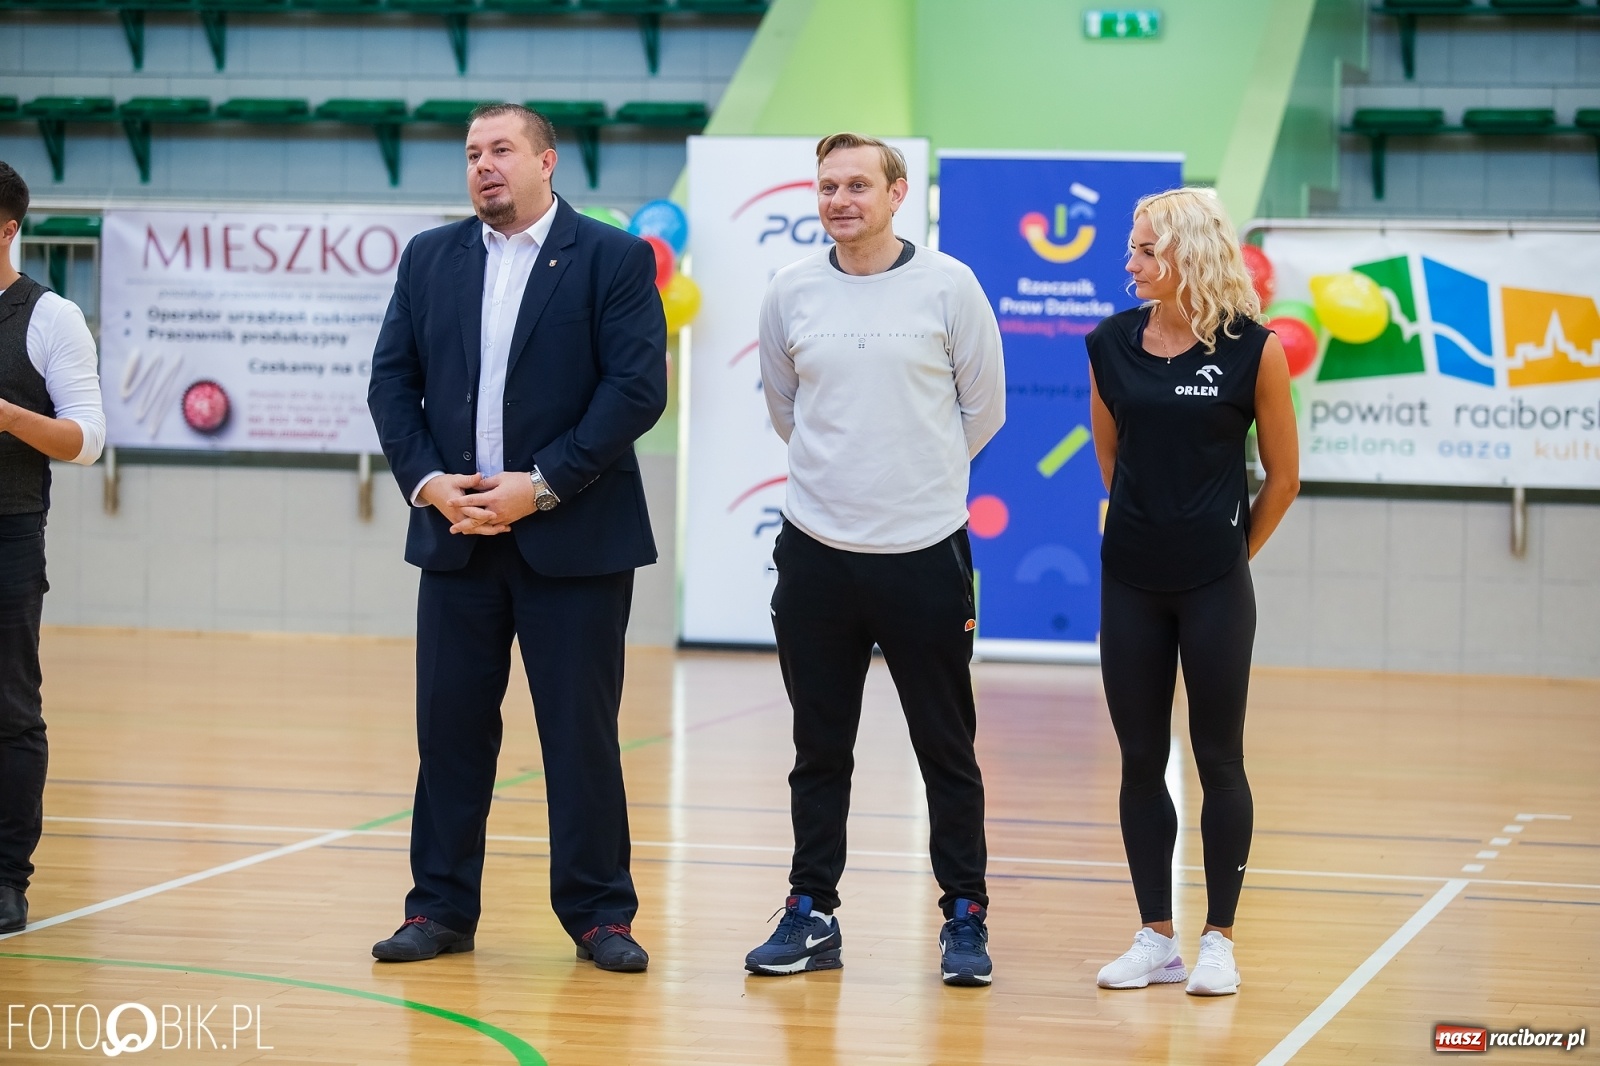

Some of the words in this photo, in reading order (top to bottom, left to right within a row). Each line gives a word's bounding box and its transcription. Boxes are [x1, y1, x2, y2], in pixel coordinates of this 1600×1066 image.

[142, 222, 398, 277] MIESZKO
[1018, 277, 1096, 296] Rzecznik
[147, 305, 221, 324] Operator
[1000, 297, 1043, 315] Praw
[1044, 298, 1115, 317] Dziecka
[148, 328, 235, 342] Pracownik
[241, 330, 347, 346] produkcyjny
[248, 357, 323, 378] Czekamy
[332, 362, 350, 375] na
[1175, 385, 1218, 397] ORLEN
[1310, 394, 1430, 432] powiat
[1309, 433, 1416, 457] zielona
[1437, 439, 1512, 460] oaza
